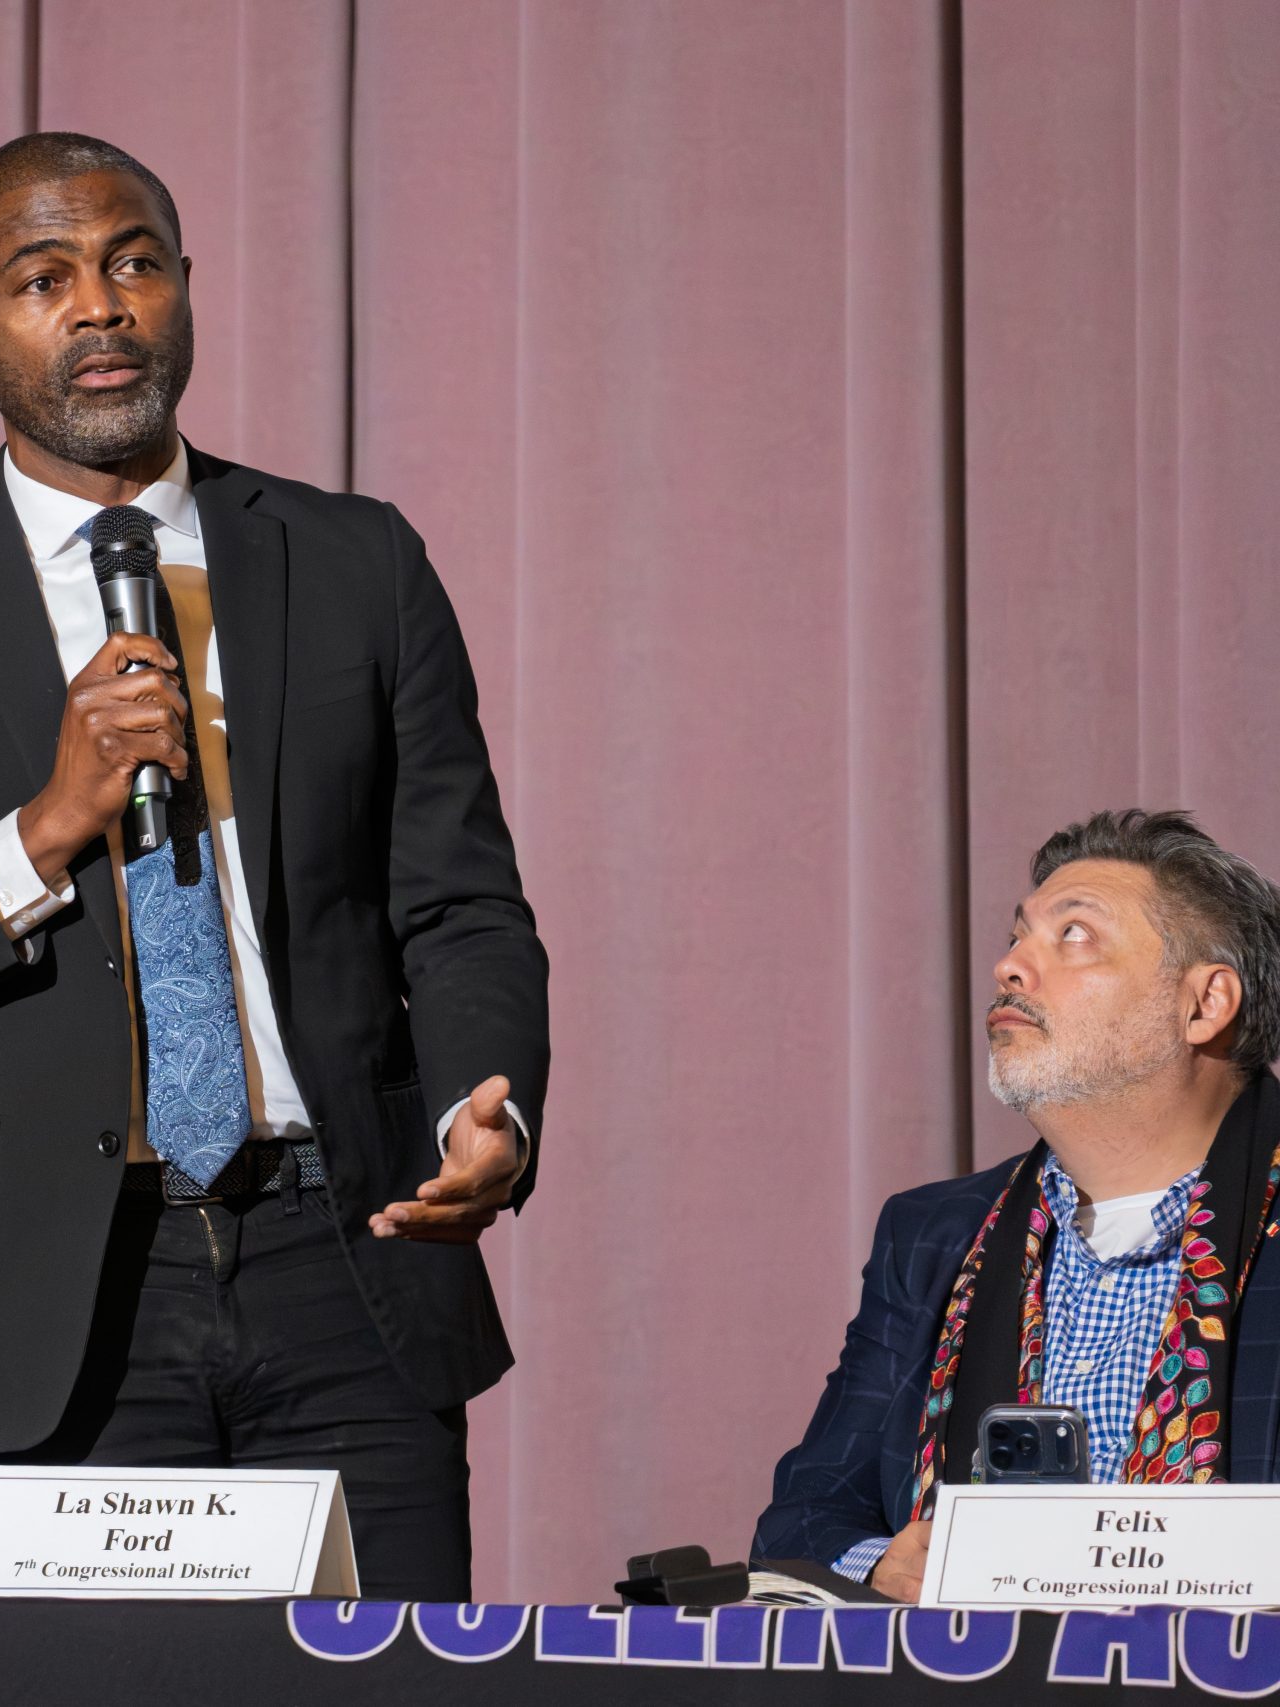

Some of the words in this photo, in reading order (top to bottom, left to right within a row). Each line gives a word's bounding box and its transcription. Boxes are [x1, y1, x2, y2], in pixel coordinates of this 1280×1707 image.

[53, 1491, 91, 1515] La
[100, 1491, 195, 1516] Shawn
[204, 1493, 237, 1517] K.
[1094, 1509, 1167, 1534] Felix
[102, 1528, 173, 1553] Ford
[1088, 1545, 1165, 1570] Tello
[13, 1558, 37, 1579] 7th
[40, 1560, 176, 1583] Congressional
[179, 1562, 252, 1580] District
[991, 1574, 1017, 1595] 7th
[1022, 1577, 1170, 1598] Congressional
[1175, 1578, 1253, 1596] District
